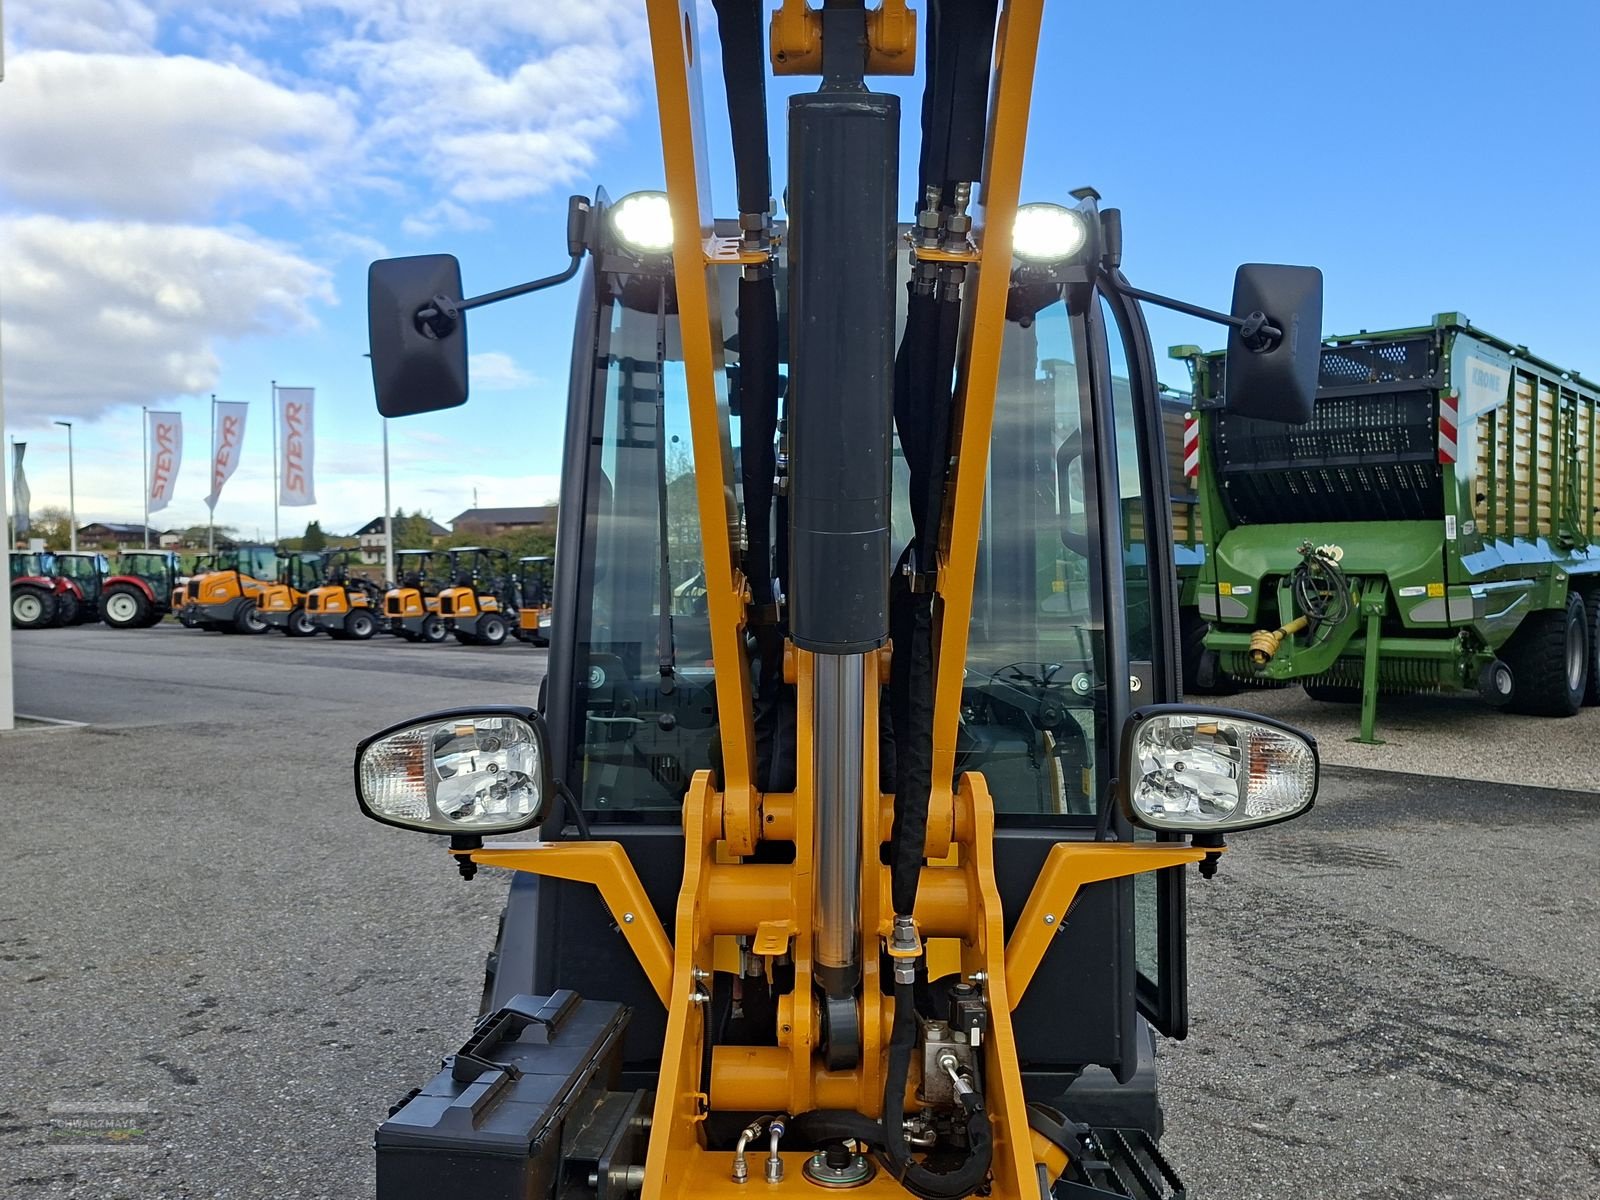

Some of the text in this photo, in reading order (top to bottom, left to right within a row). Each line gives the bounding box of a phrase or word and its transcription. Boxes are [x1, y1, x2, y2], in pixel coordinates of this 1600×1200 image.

[1472, 368, 1500, 392] KRONE
[152, 424, 172, 498] STEYR
[285, 402, 304, 494] STEYR
